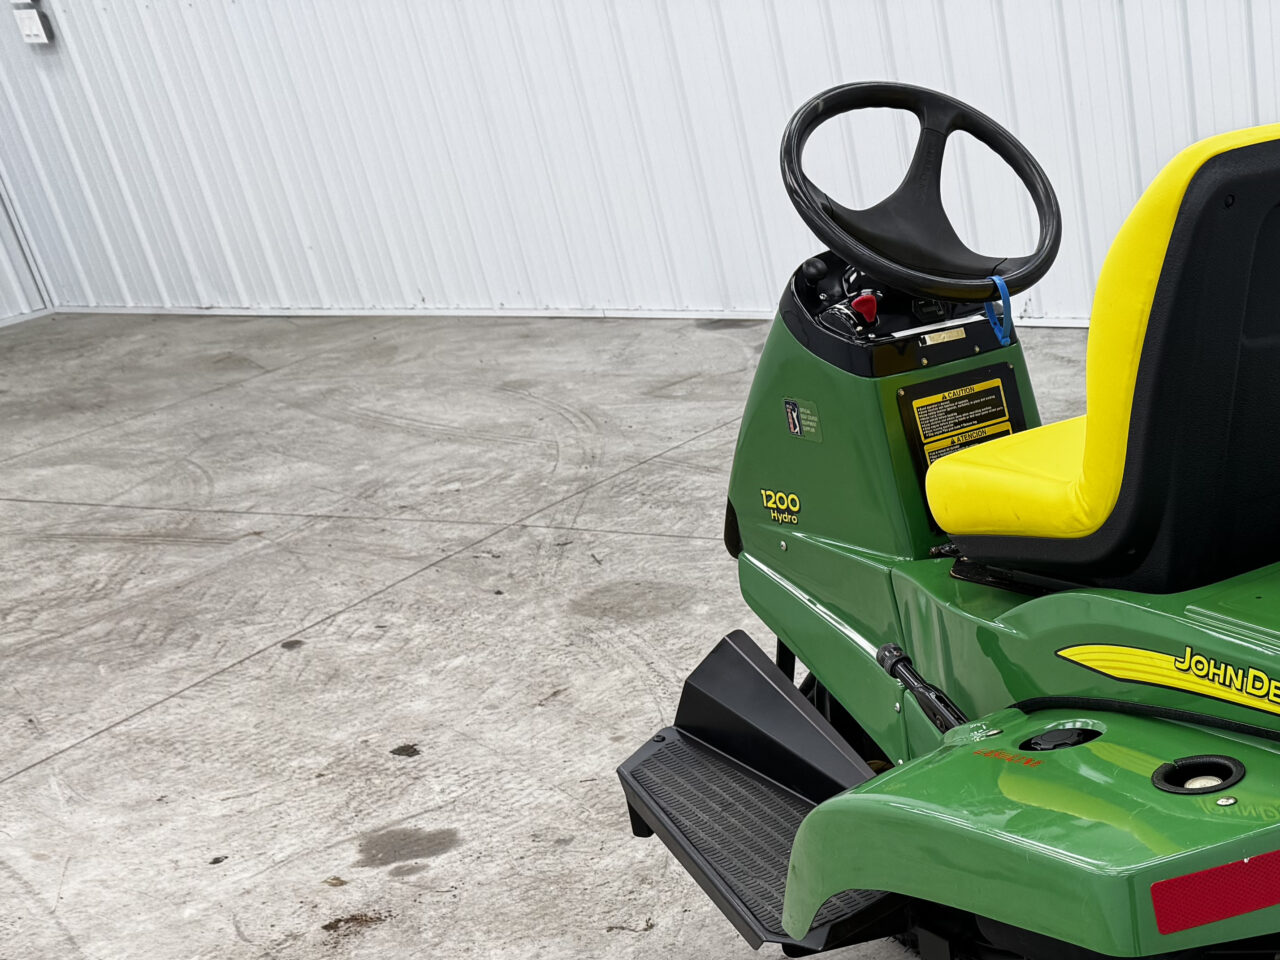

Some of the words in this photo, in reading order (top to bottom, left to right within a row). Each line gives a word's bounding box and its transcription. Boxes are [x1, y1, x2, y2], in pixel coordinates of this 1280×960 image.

[947, 386, 976, 399] CAUTION
[760, 489, 800, 512] 1200
[771, 510, 798, 524] Hydro
[1174, 645, 1245, 692] JOHN
